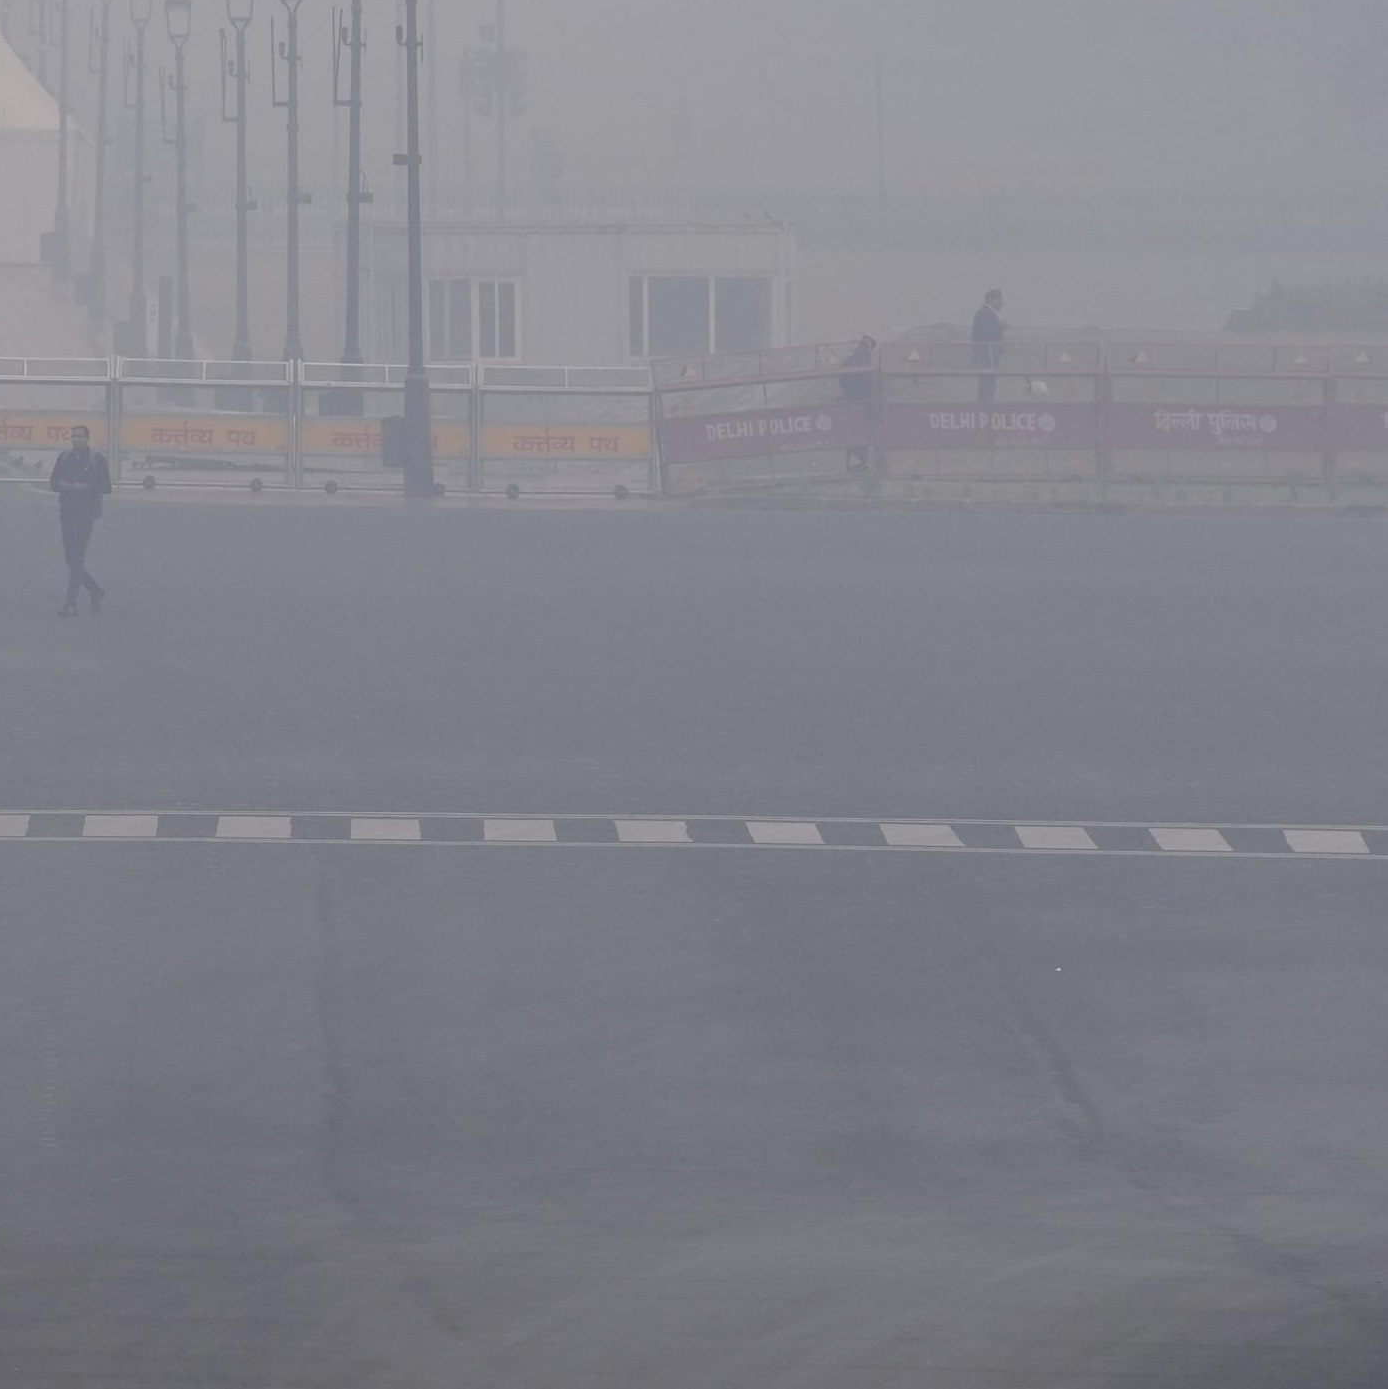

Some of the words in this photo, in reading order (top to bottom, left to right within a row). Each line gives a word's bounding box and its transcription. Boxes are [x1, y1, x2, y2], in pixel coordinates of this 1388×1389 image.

[706, 422, 754, 441] DELHI
[758, 416, 813, 437] POLICE
[930, 412, 975, 430] DELHI
[979, 412, 1036, 431] POLICE
[1154, 409, 1203, 434] दिल्ली
[1206, 409, 1257, 435] पुलिस
[227, 430, 257, 446] पथ
[589, 436, 619, 453] पथ
